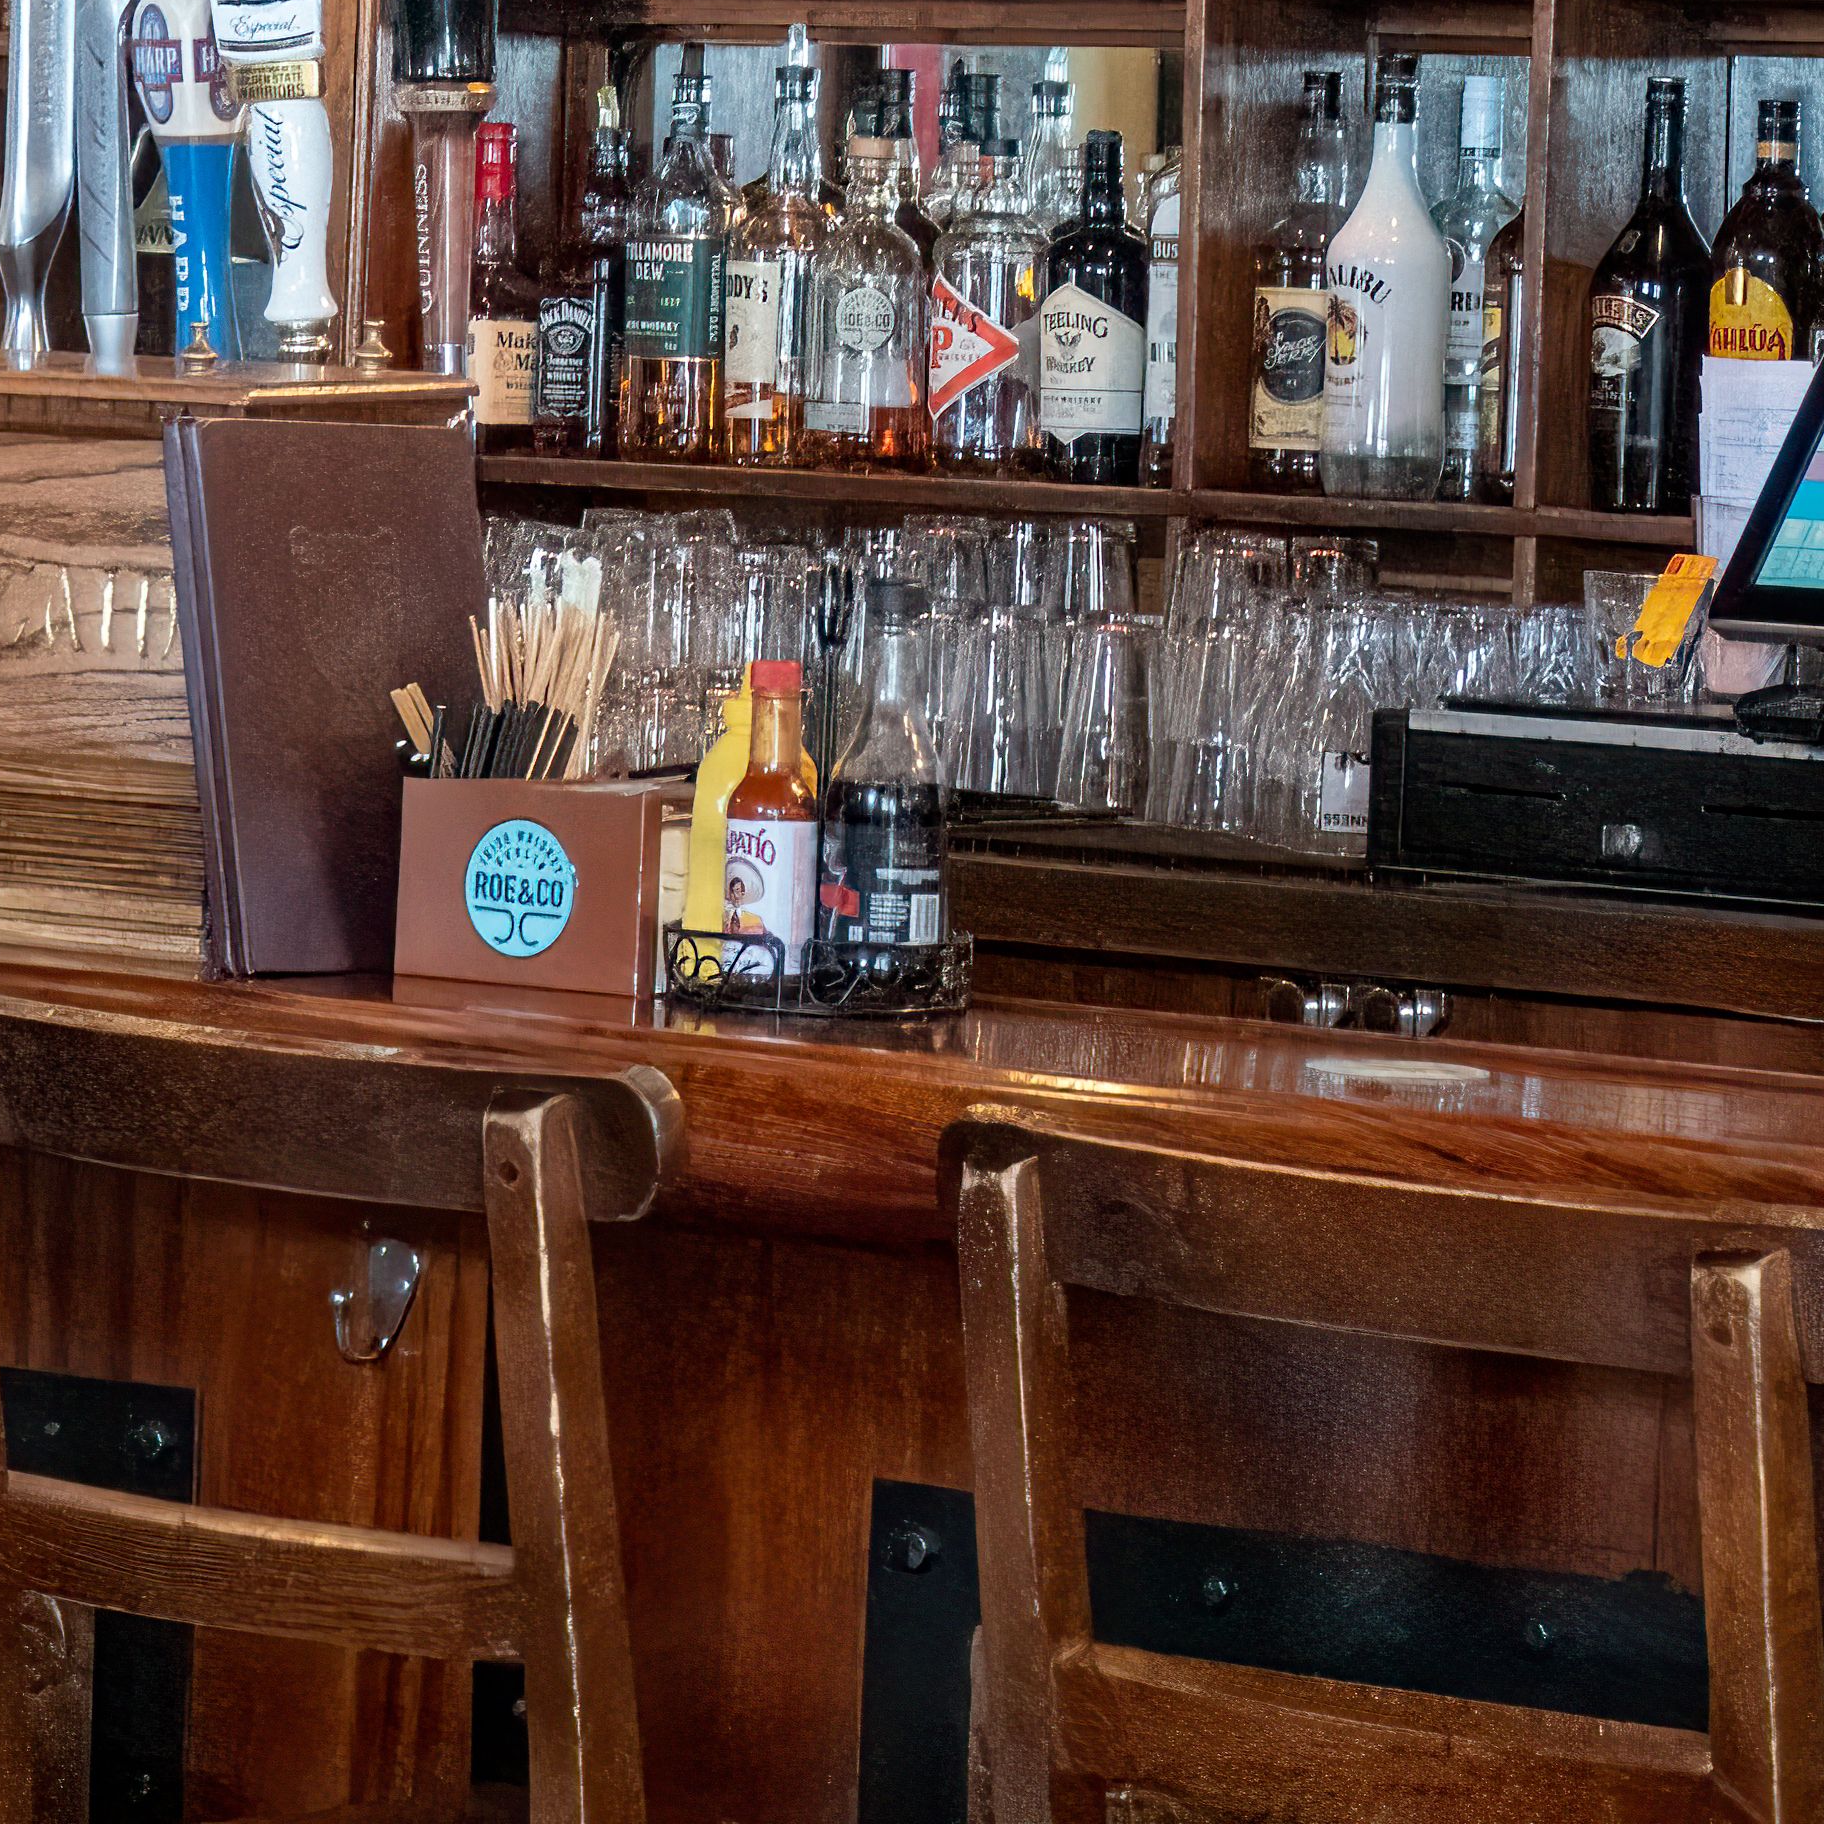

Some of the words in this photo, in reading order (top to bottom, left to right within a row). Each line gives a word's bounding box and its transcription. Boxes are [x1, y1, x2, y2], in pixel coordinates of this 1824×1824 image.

[414, 162, 435, 315] GUINNESS
[1043, 311, 1109, 338] TEELING
[474, 870, 565, 909] ROE&CO
